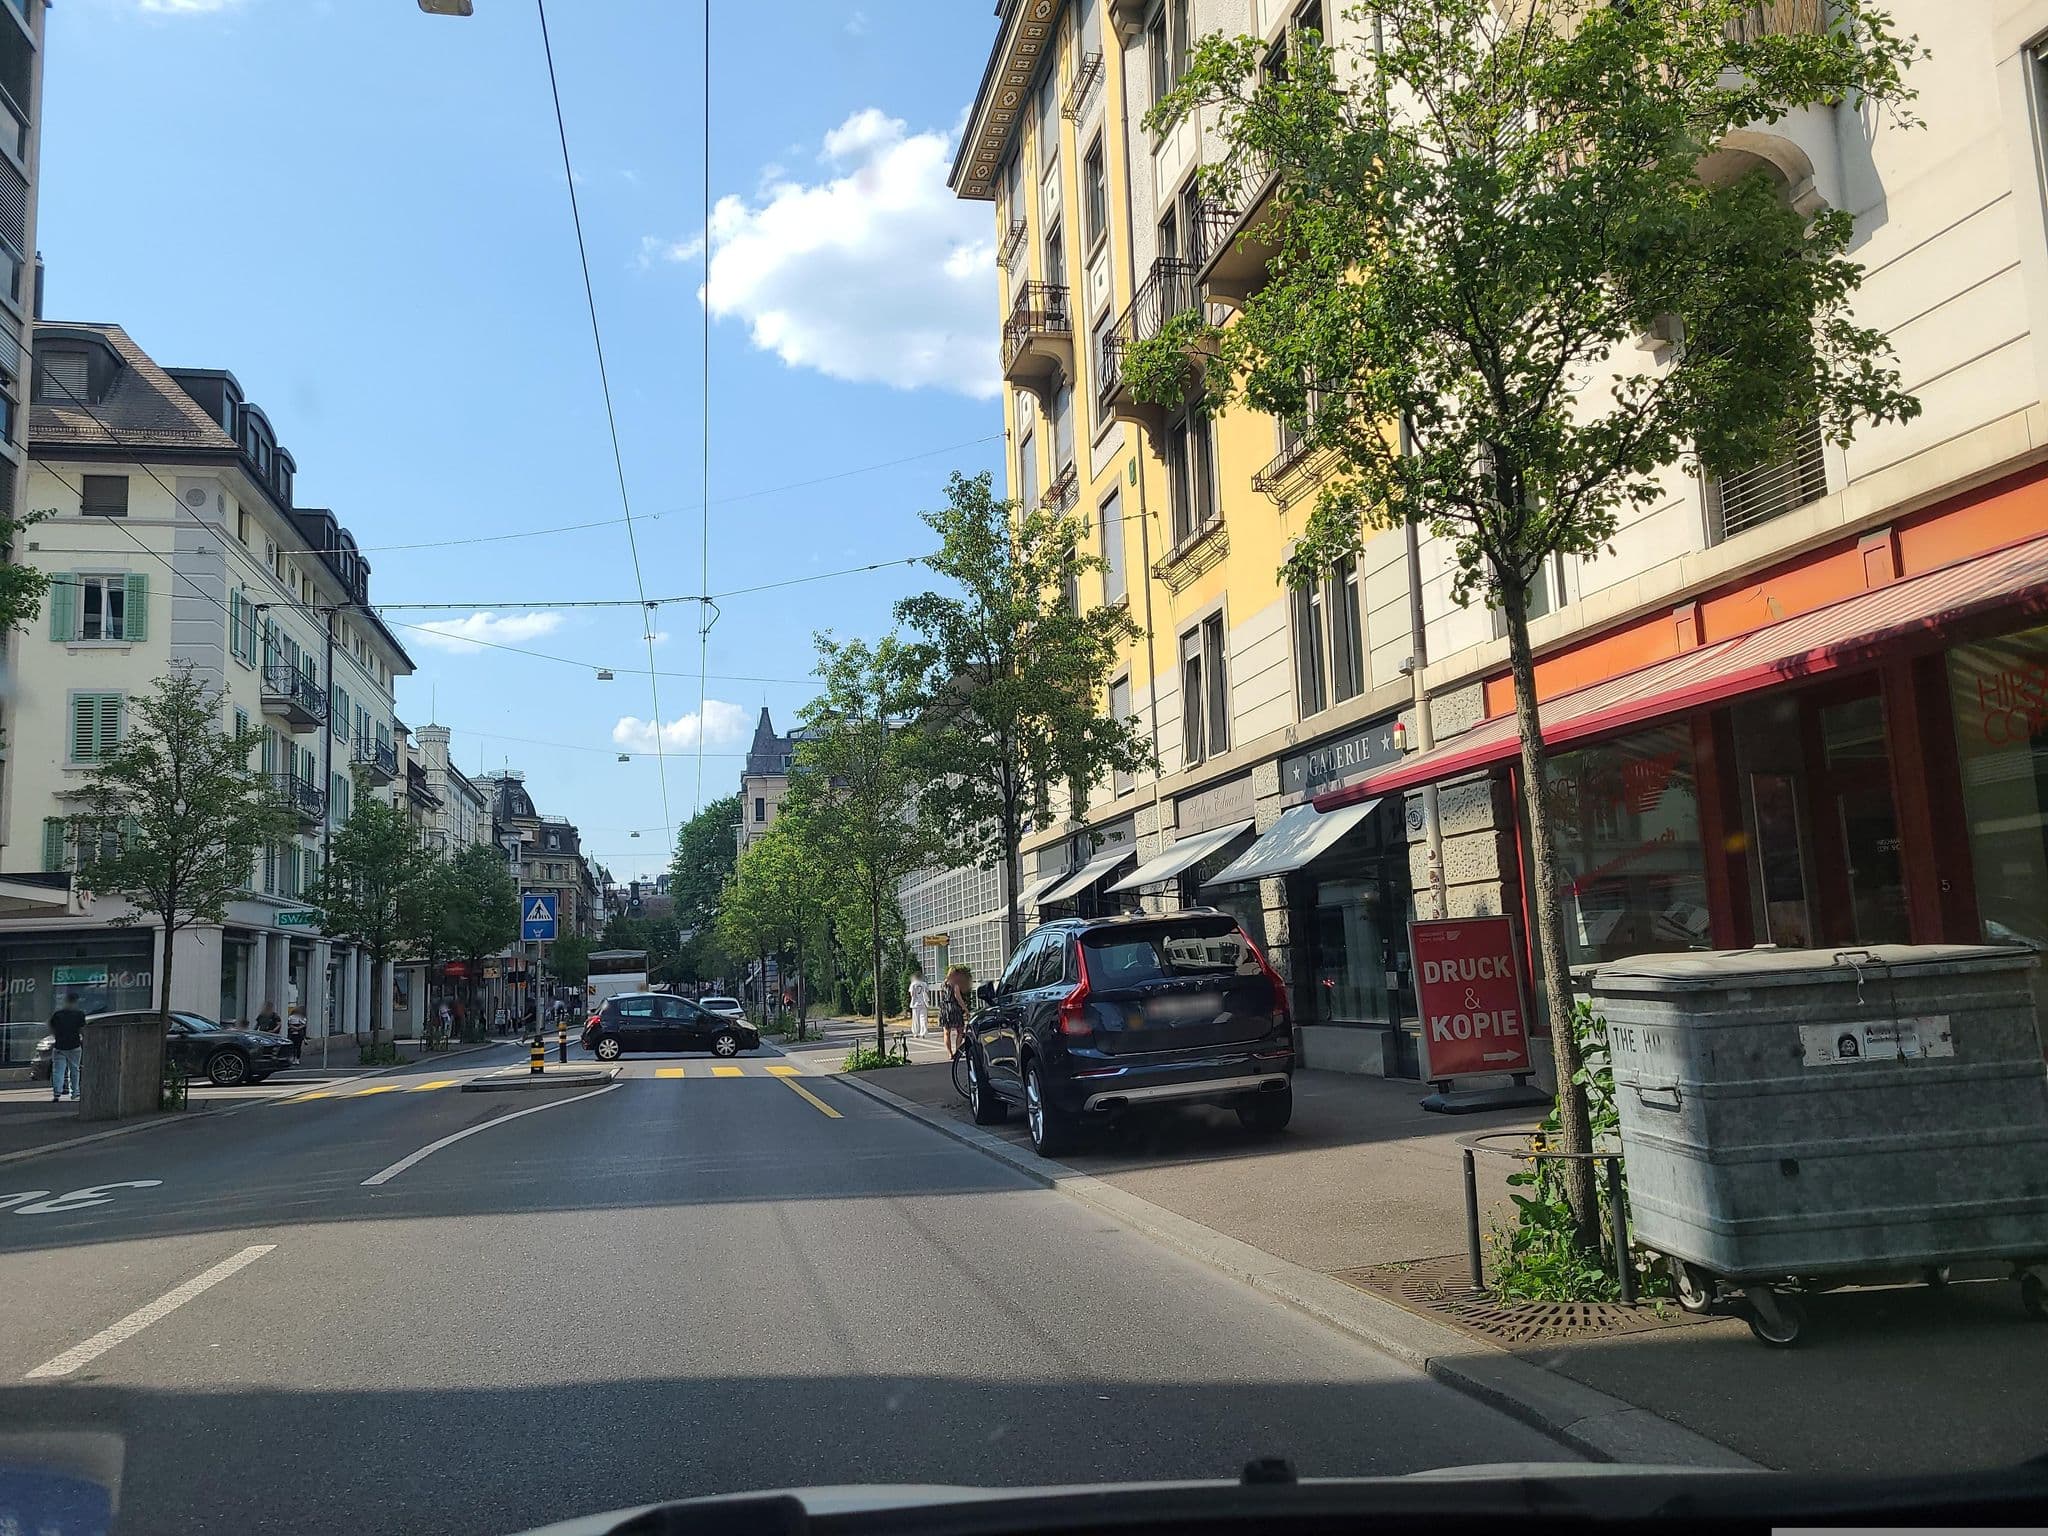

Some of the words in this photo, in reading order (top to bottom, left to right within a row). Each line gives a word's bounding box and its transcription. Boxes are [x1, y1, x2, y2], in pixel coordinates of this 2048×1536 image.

[1309, 737, 1370, 777] GALERIE
[1941, 879, 1951, 893] 5
[1423, 955, 1512, 985] DRUCK
[1464, 987, 1481, 1010] &
[1431, 1009, 1519, 1043] KOPIE
[1612, 1027, 1637, 1053] THE
